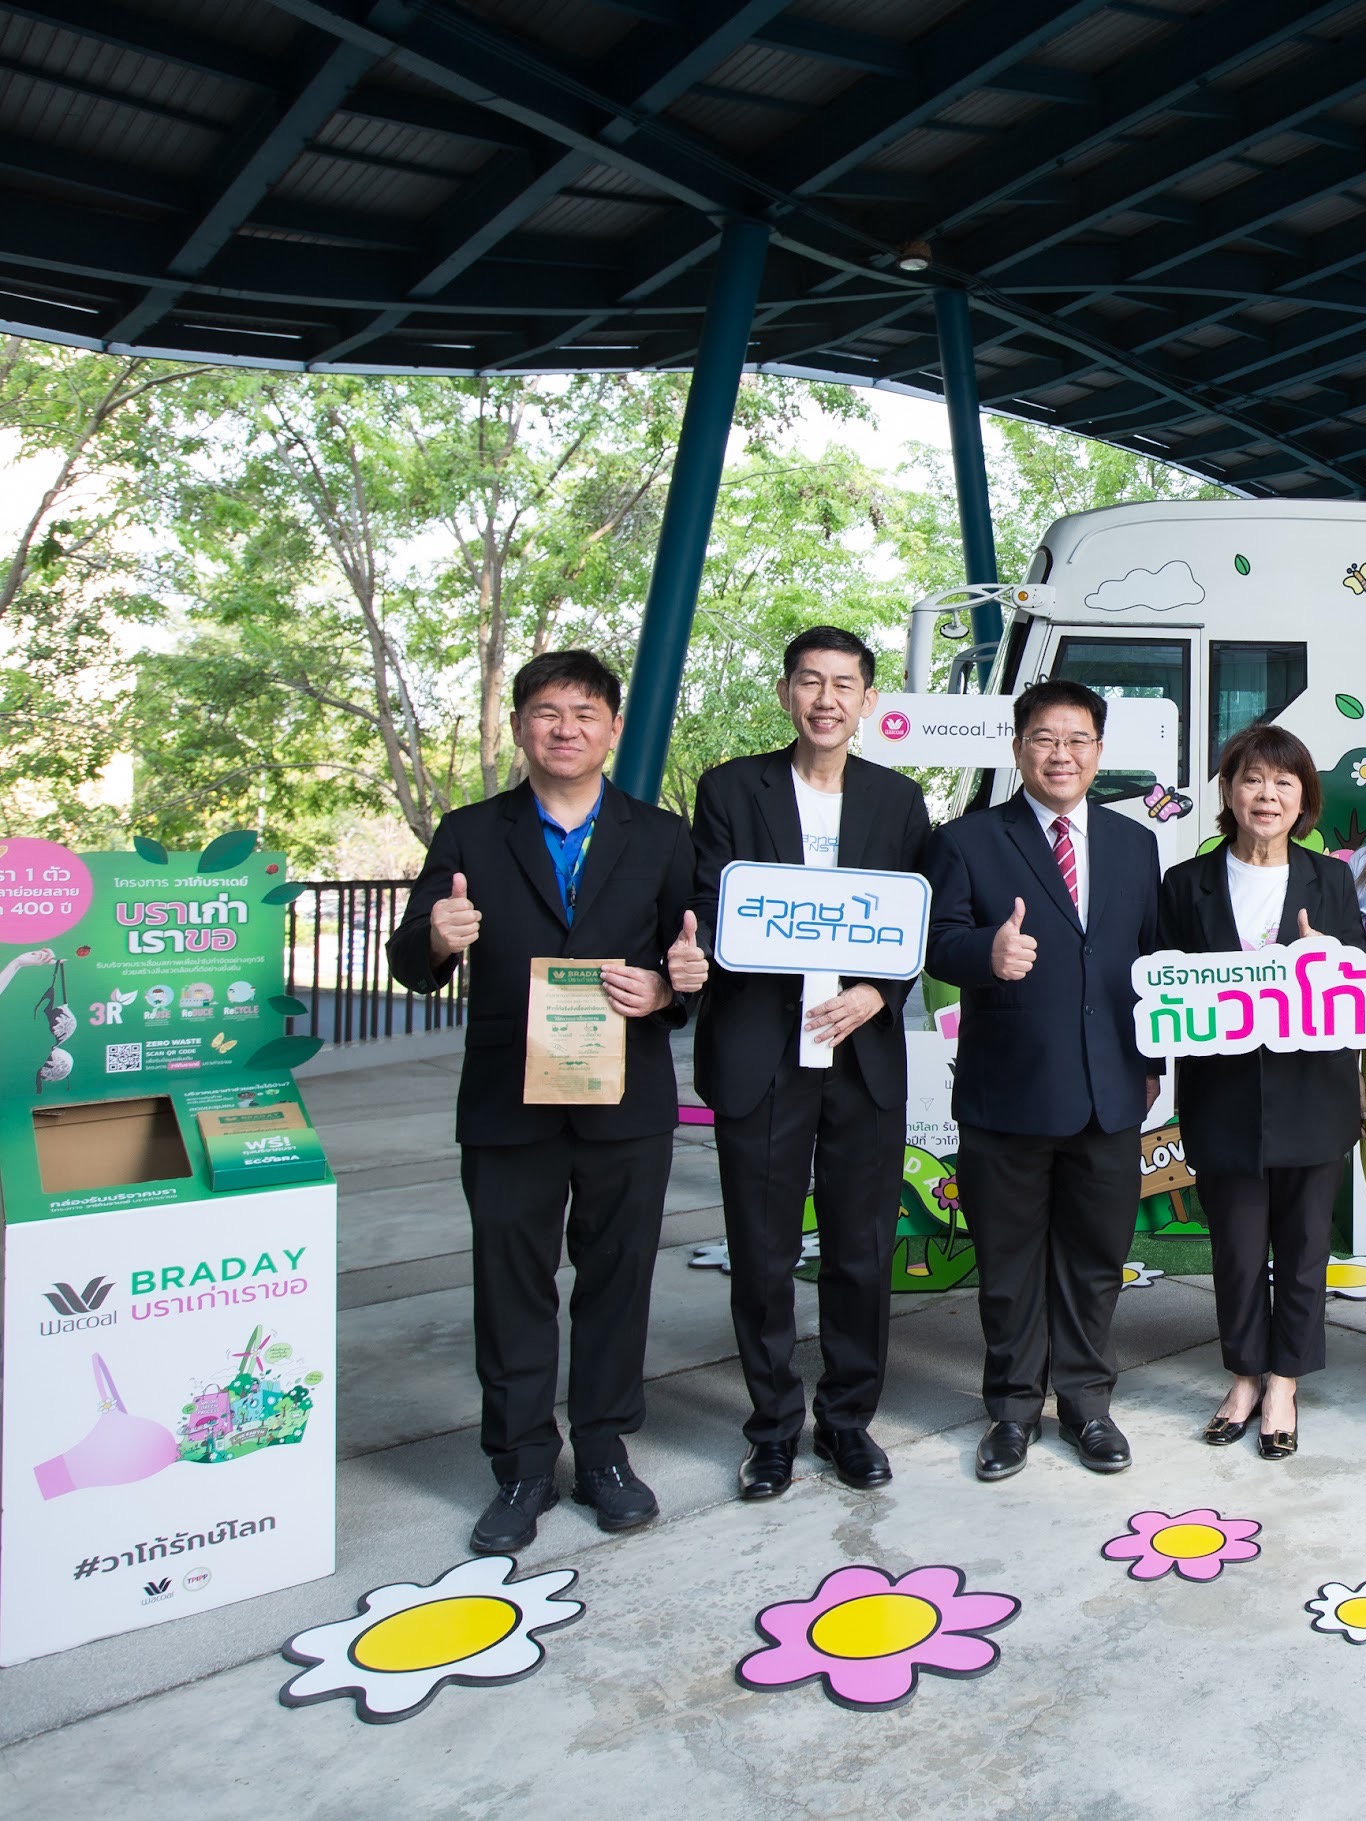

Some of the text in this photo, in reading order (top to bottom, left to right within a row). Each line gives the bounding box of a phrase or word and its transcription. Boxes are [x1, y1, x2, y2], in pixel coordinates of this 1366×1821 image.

[922, 721, 1014, 739] wacoal_th
[809, 844, 839, 852] NST
[26, 868, 33, 881] 1
[43, 866, 71, 882] ตัว
[114, 875, 248, 888] โครงการ วาโก้บราเดย์
[11, 902, 54, 915] 400
[60, 902, 72, 914] ปี
[116, 893, 248, 926] บราเก่า
[128, 928, 237, 954] เราขอ
[766, 919, 904, 946] NSTDA
[1147, 959, 1287, 986] บริจาคบราเก่า
[89, 1001, 123, 1026] 3R
[244, 1136, 291, 1151] ฟรี!
[1140, 1139, 1186, 1175] LOV
[50, 1188, 176, 1208] กล่องรับบริจาคบรา
[131, 1247, 307, 1295] BRADAY
[131, 1277, 308, 1321] บราเก่าเราขอ
[40, 1310, 117, 1336] Wacoal
[73, 1515, 276, 1581] #วาโก้รักษ์โลก
